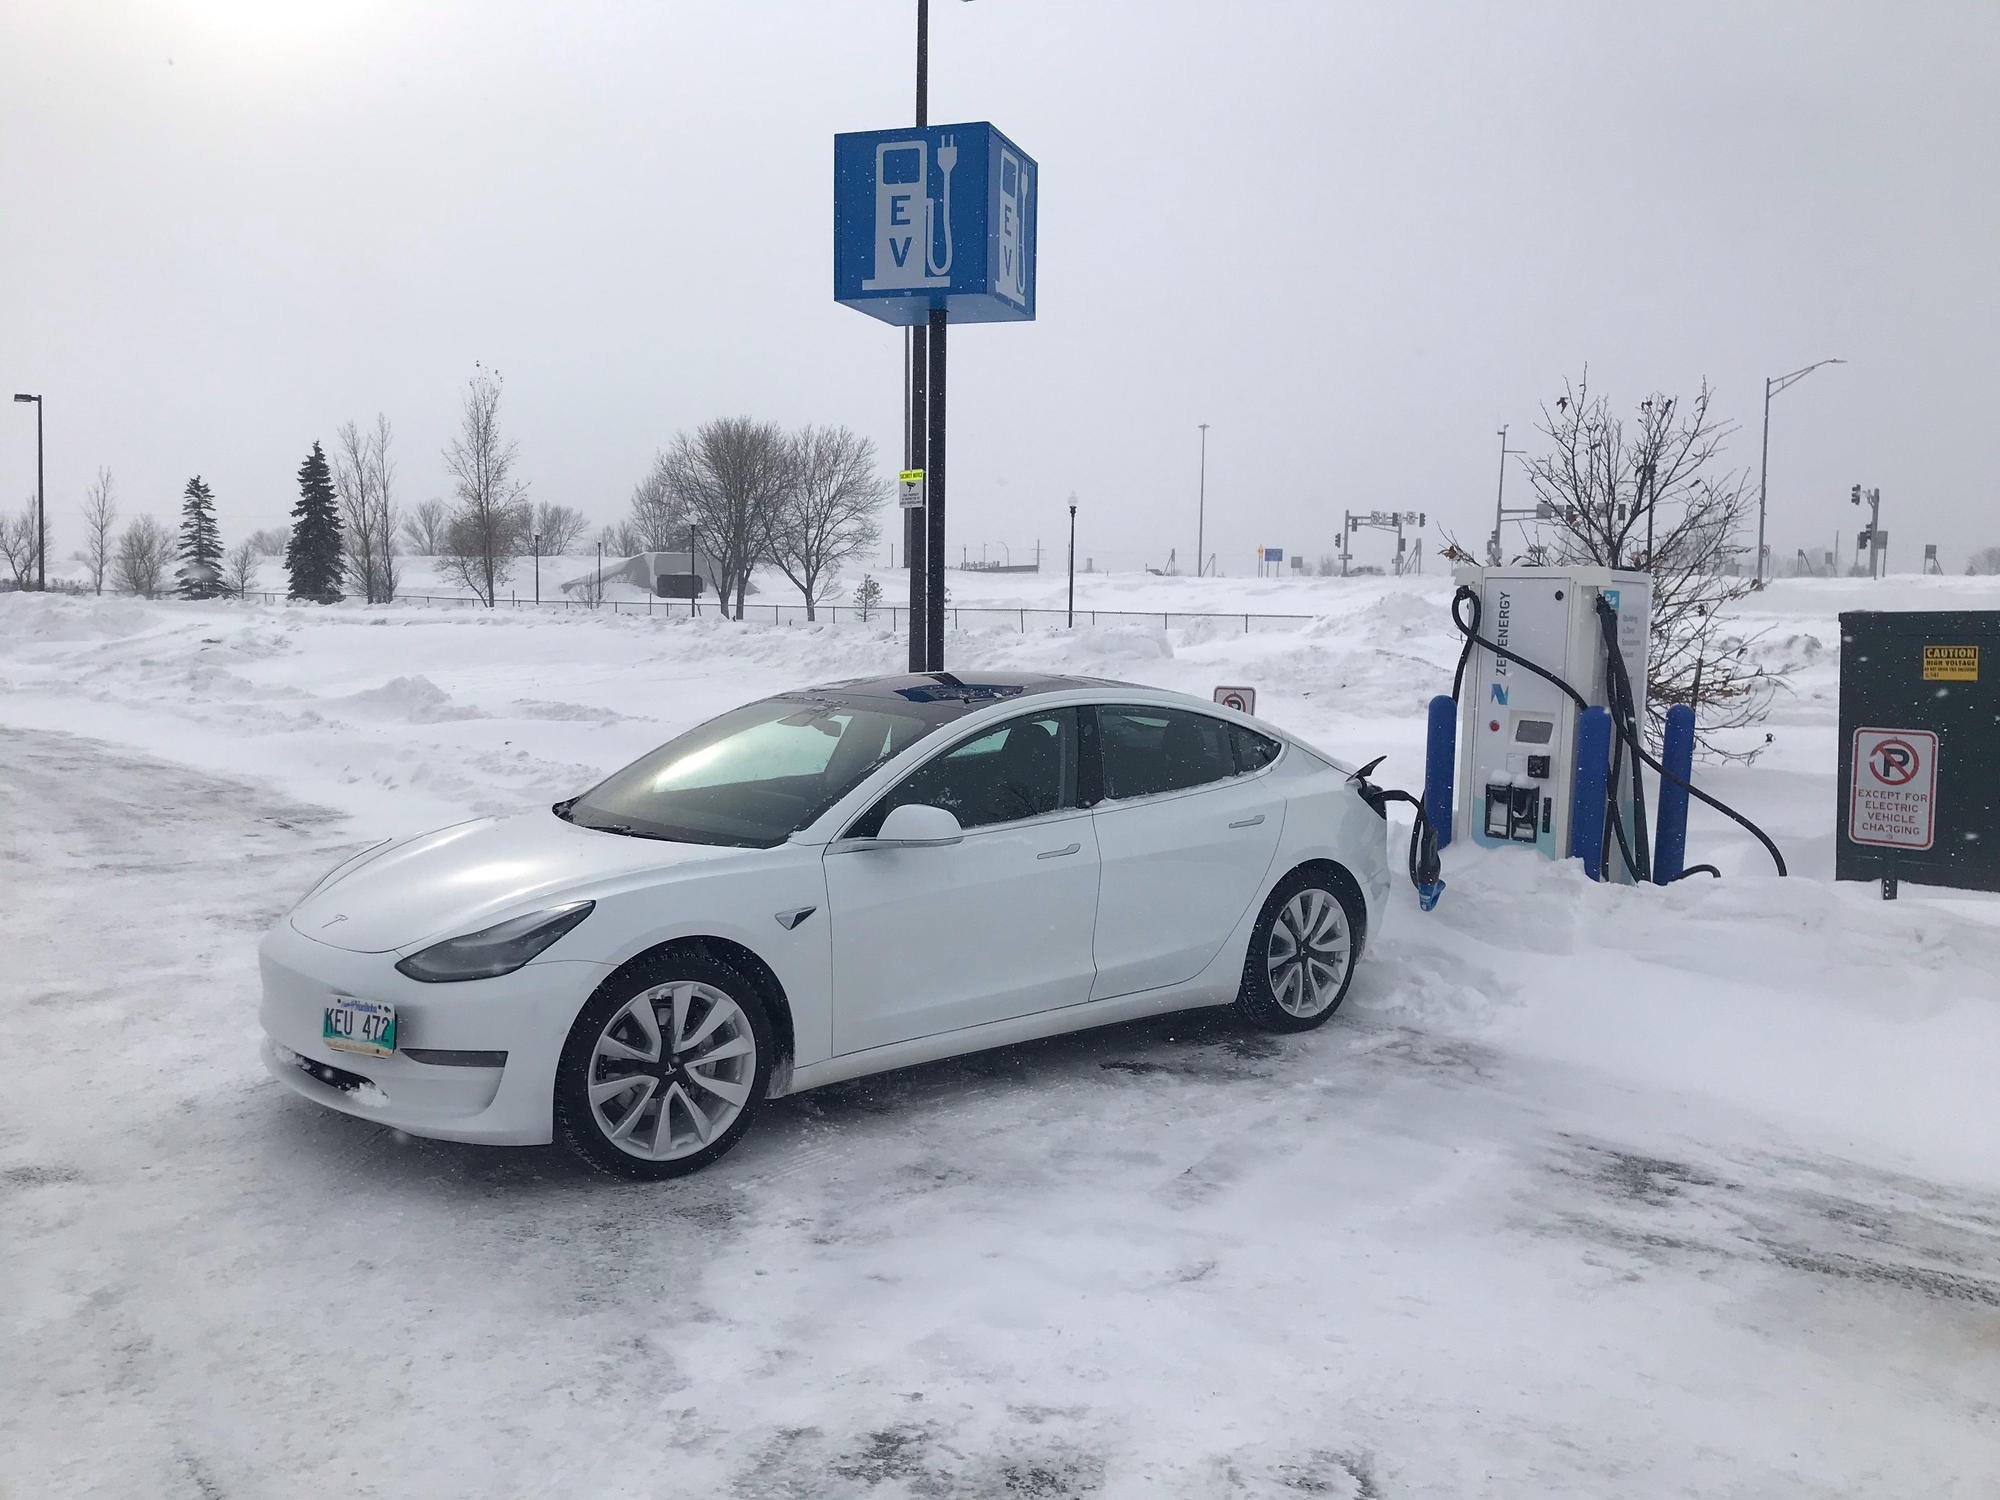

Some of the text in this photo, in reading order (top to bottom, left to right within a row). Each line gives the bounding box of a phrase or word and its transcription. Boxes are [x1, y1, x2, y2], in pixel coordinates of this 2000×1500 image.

[889, 195, 912, 267] EV
[1926, 648, 1975, 658] CAUTION
[1858, 789, 1928, 802] EXCEPT FOR
[1865, 801, 1919, 812] ELECTRIC
[1867, 812, 1916, 824] VEHICLE
[1862, 823, 1920, 835] CHARGING
[325, 1008, 390, 1042] KEU 472
